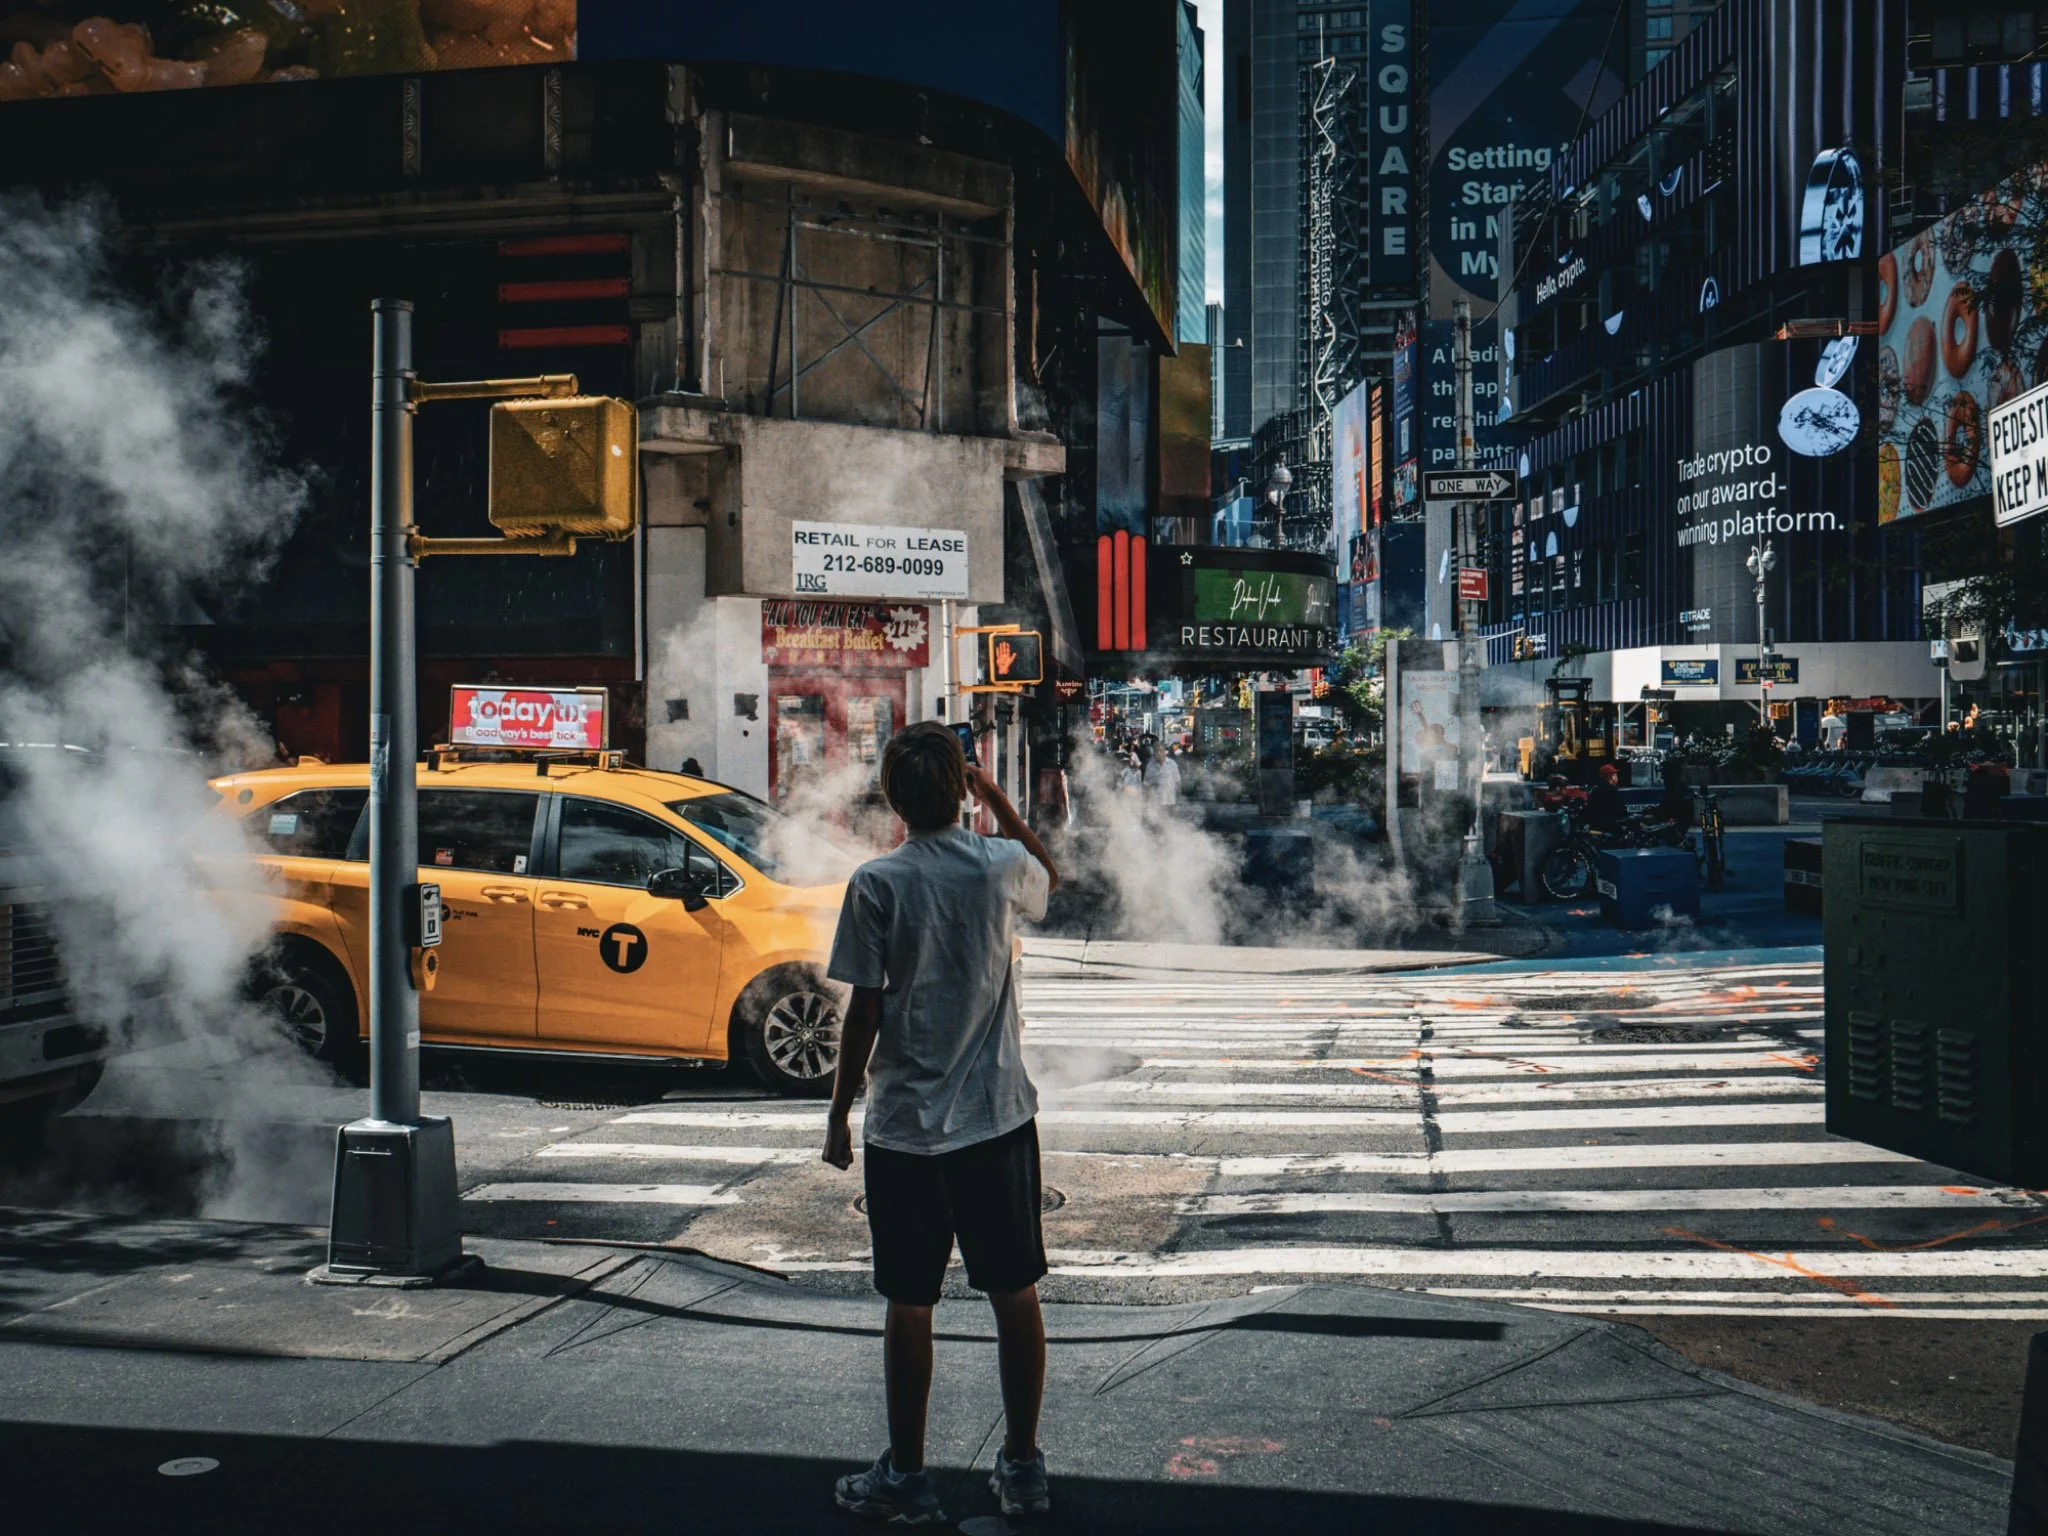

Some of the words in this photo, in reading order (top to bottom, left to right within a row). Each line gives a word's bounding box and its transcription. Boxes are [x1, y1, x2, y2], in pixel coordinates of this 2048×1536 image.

[1378, 24, 1409, 255] SQUARE
[1448, 143, 1552, 173] Setting
[1311, 152, 1321, 218] EAGLE
[1451, 216, 1476, 241] in
[1311, 220, 1321, 339] AMERICAN
[1557, 256, 1587, 289] crypto.
[1432, 348, 1446, 364] A
[1993, 395, 2048, 460] PEDEST
[1677, 452, 1705, 482] Trade
[1707, 443, 1771, 475] crypto
[1437, 480, 1464, 492] ONE
[1475, 478, 1502, 491] WAY
[1677, 495, 1691, 515] on
[1692, 489, 1709, 511] our
[1711, 472, 1787, 506] award-
[1996, 464, 2031, 514] KEEP
[794, 531, 860, 548] RETAIL
[866, 536, 896, 549] FOR
[906, 537, 964, 552] LEASE
[1677, 518, 1718, 548] winning
[1722, 507, 1845, 543] platform.
[797, 573, 827, 588] IRG
[823, 554, 944, 576] 212-689-0099
[793, 603, 818, 627] YOU
[820, 604, 844, 629] CAN
[775, 627, 840, 650] Breakfast
[843, 630, 885, 651] Buffet
[1181, 625, 1309, 648] RESTAURANT
[468, 695, 588, 727] todaytix
[465, 726, 528, 741] Broadway's
[529, 728, 553, 740] best
[556, 729, 588, 741] ticket
[577, 927, 600, 938] NYC
[611, 931, 638, 968] T
